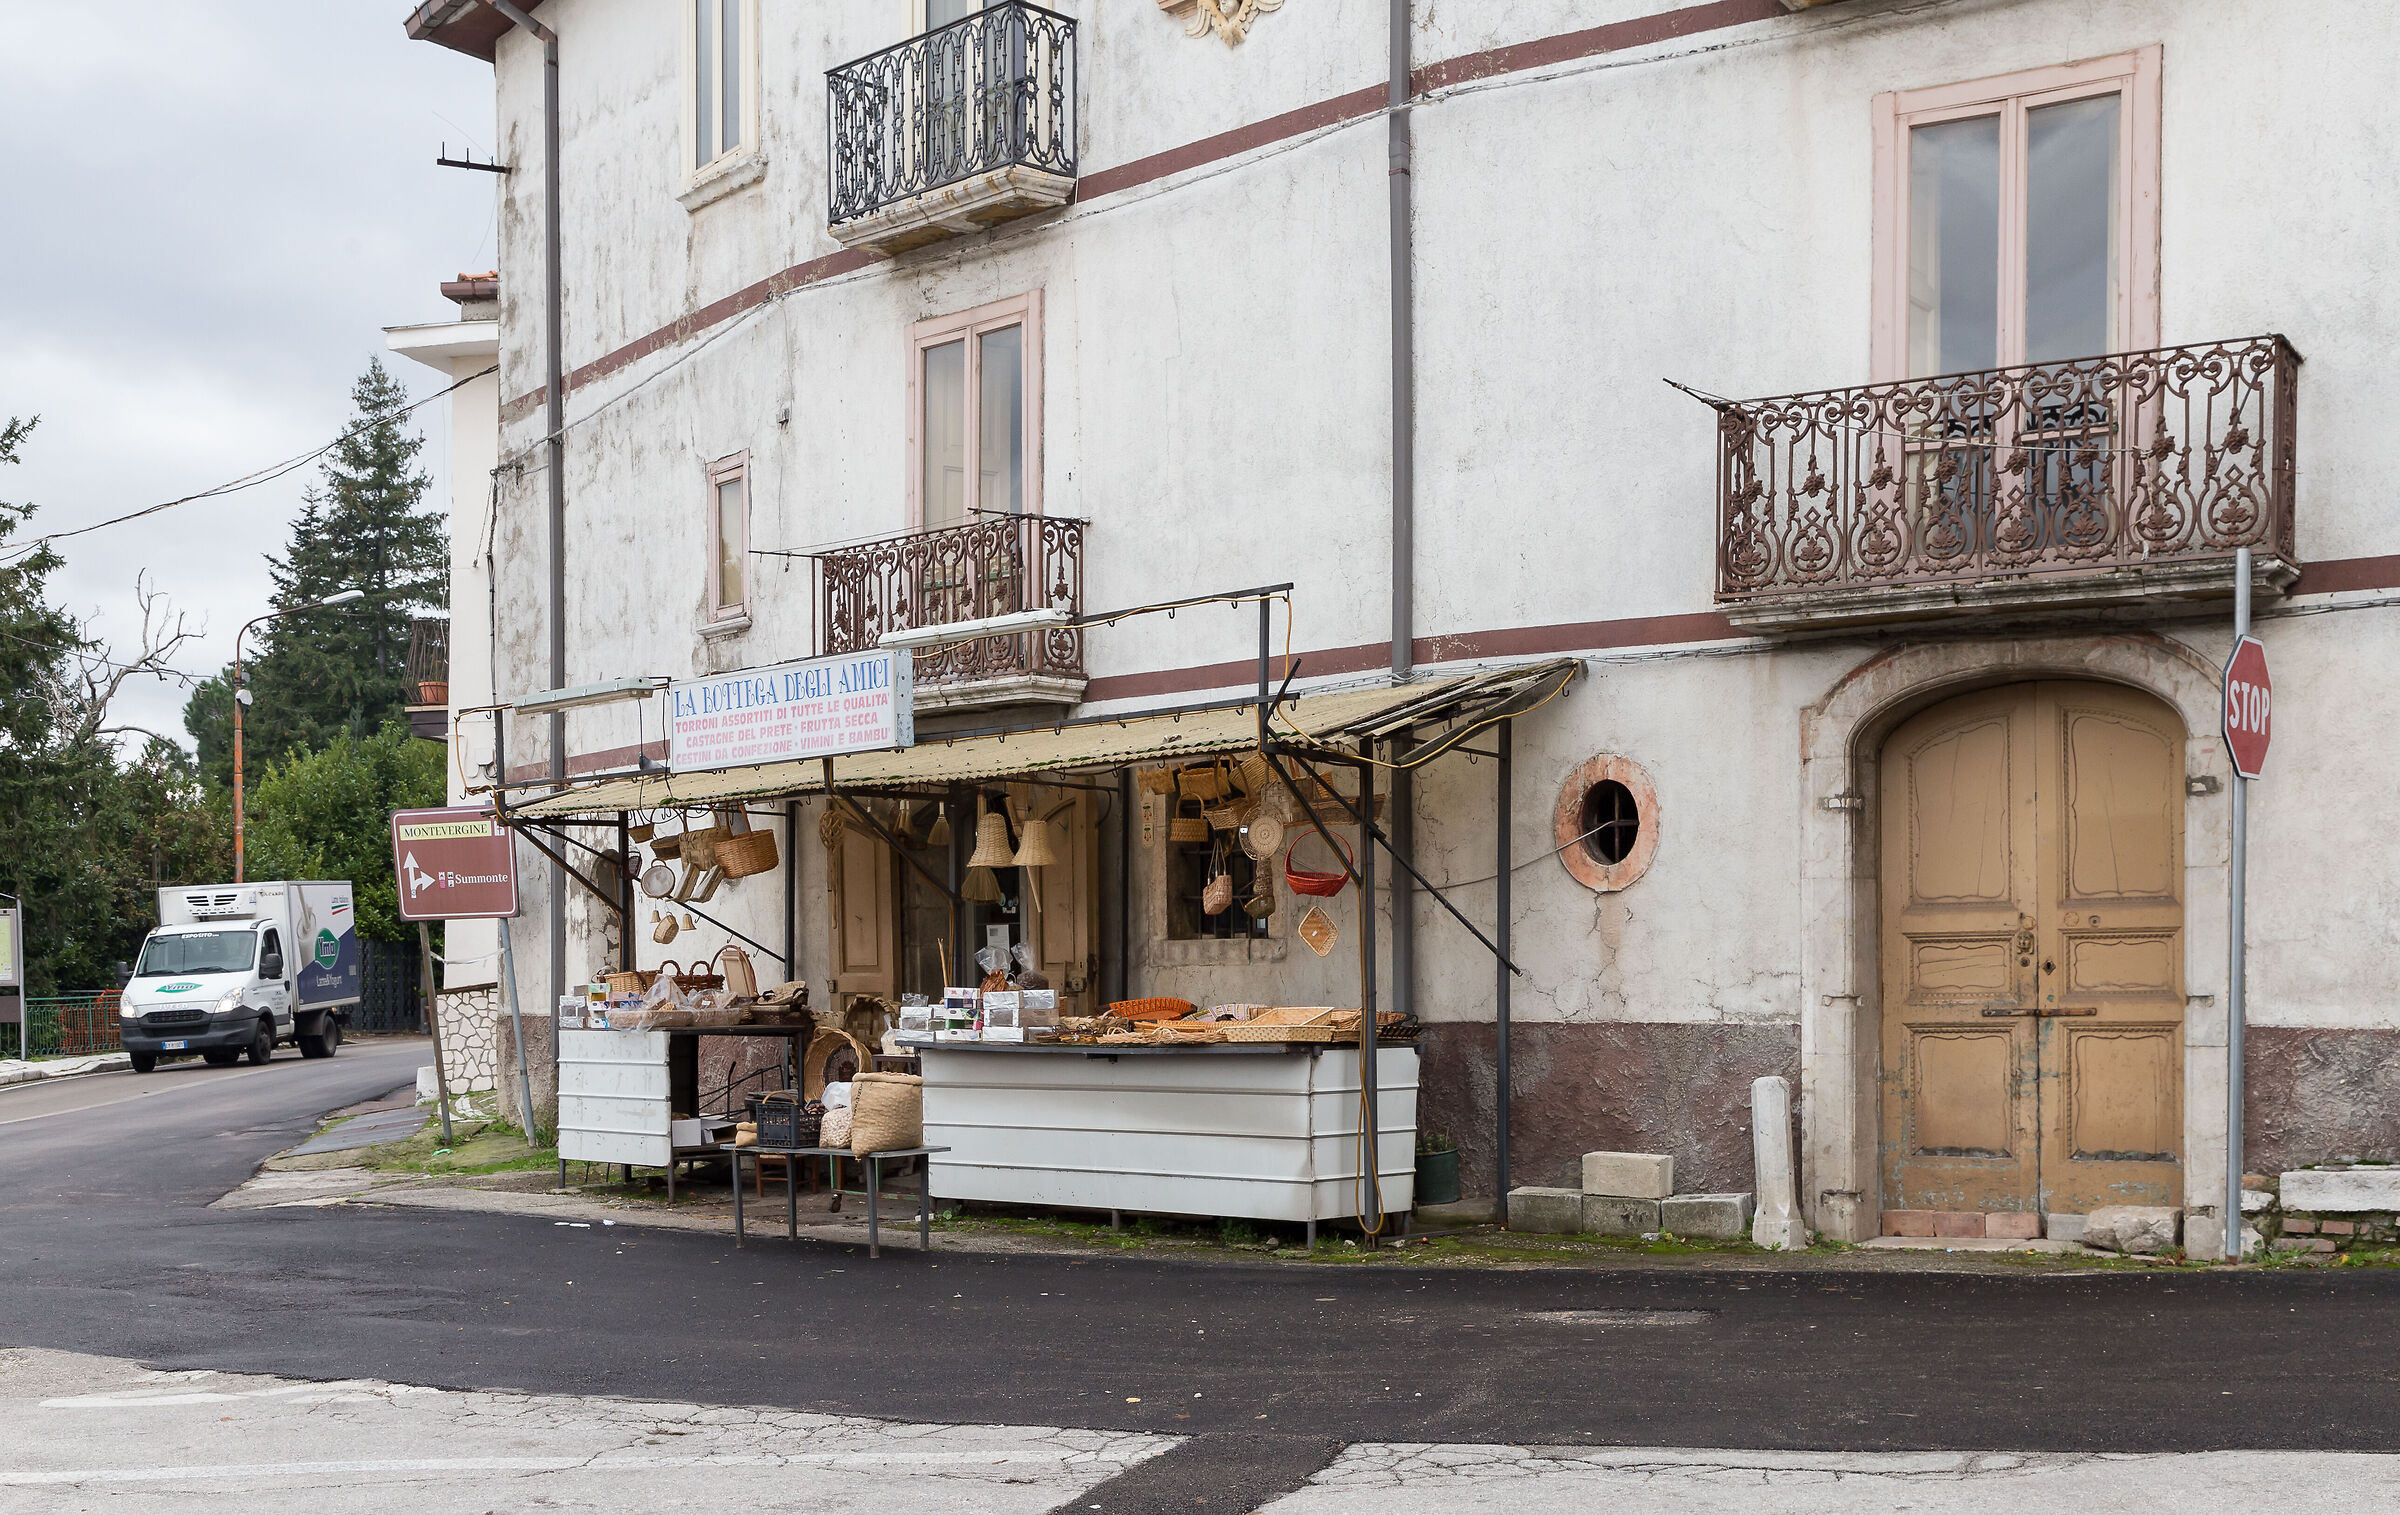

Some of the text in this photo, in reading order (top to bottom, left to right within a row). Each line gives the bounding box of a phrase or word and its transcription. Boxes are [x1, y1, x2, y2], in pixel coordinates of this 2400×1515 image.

[674, 658, 890, 718] LA BOTTEGA DEGLI AMICI
[676, 717, 718, 734] TORRONI
[722, 709, 772, 728] ASSORTITI
[777, 707, 787, 719] DI
[791, 702, 823, 718] TUTTE
[828, 700, 840, 712] LE
[2229, 680, 2270, 736] STOP
[686, 712, 878, 748] CASTAGNE DEL PRETE FRUTTA SECCA
[676, 752, 711, 766] CESTINI
[715, 749, 728, 761] DA
[732, 740, 792, 758] CONFEZIONE
[800, 735, 834, 750] VIMINI
[838, 733, 845, 745] E
[404, 824, 487, 838] MONTEVERGINE
[456, 873, 508, 884] Summonte
